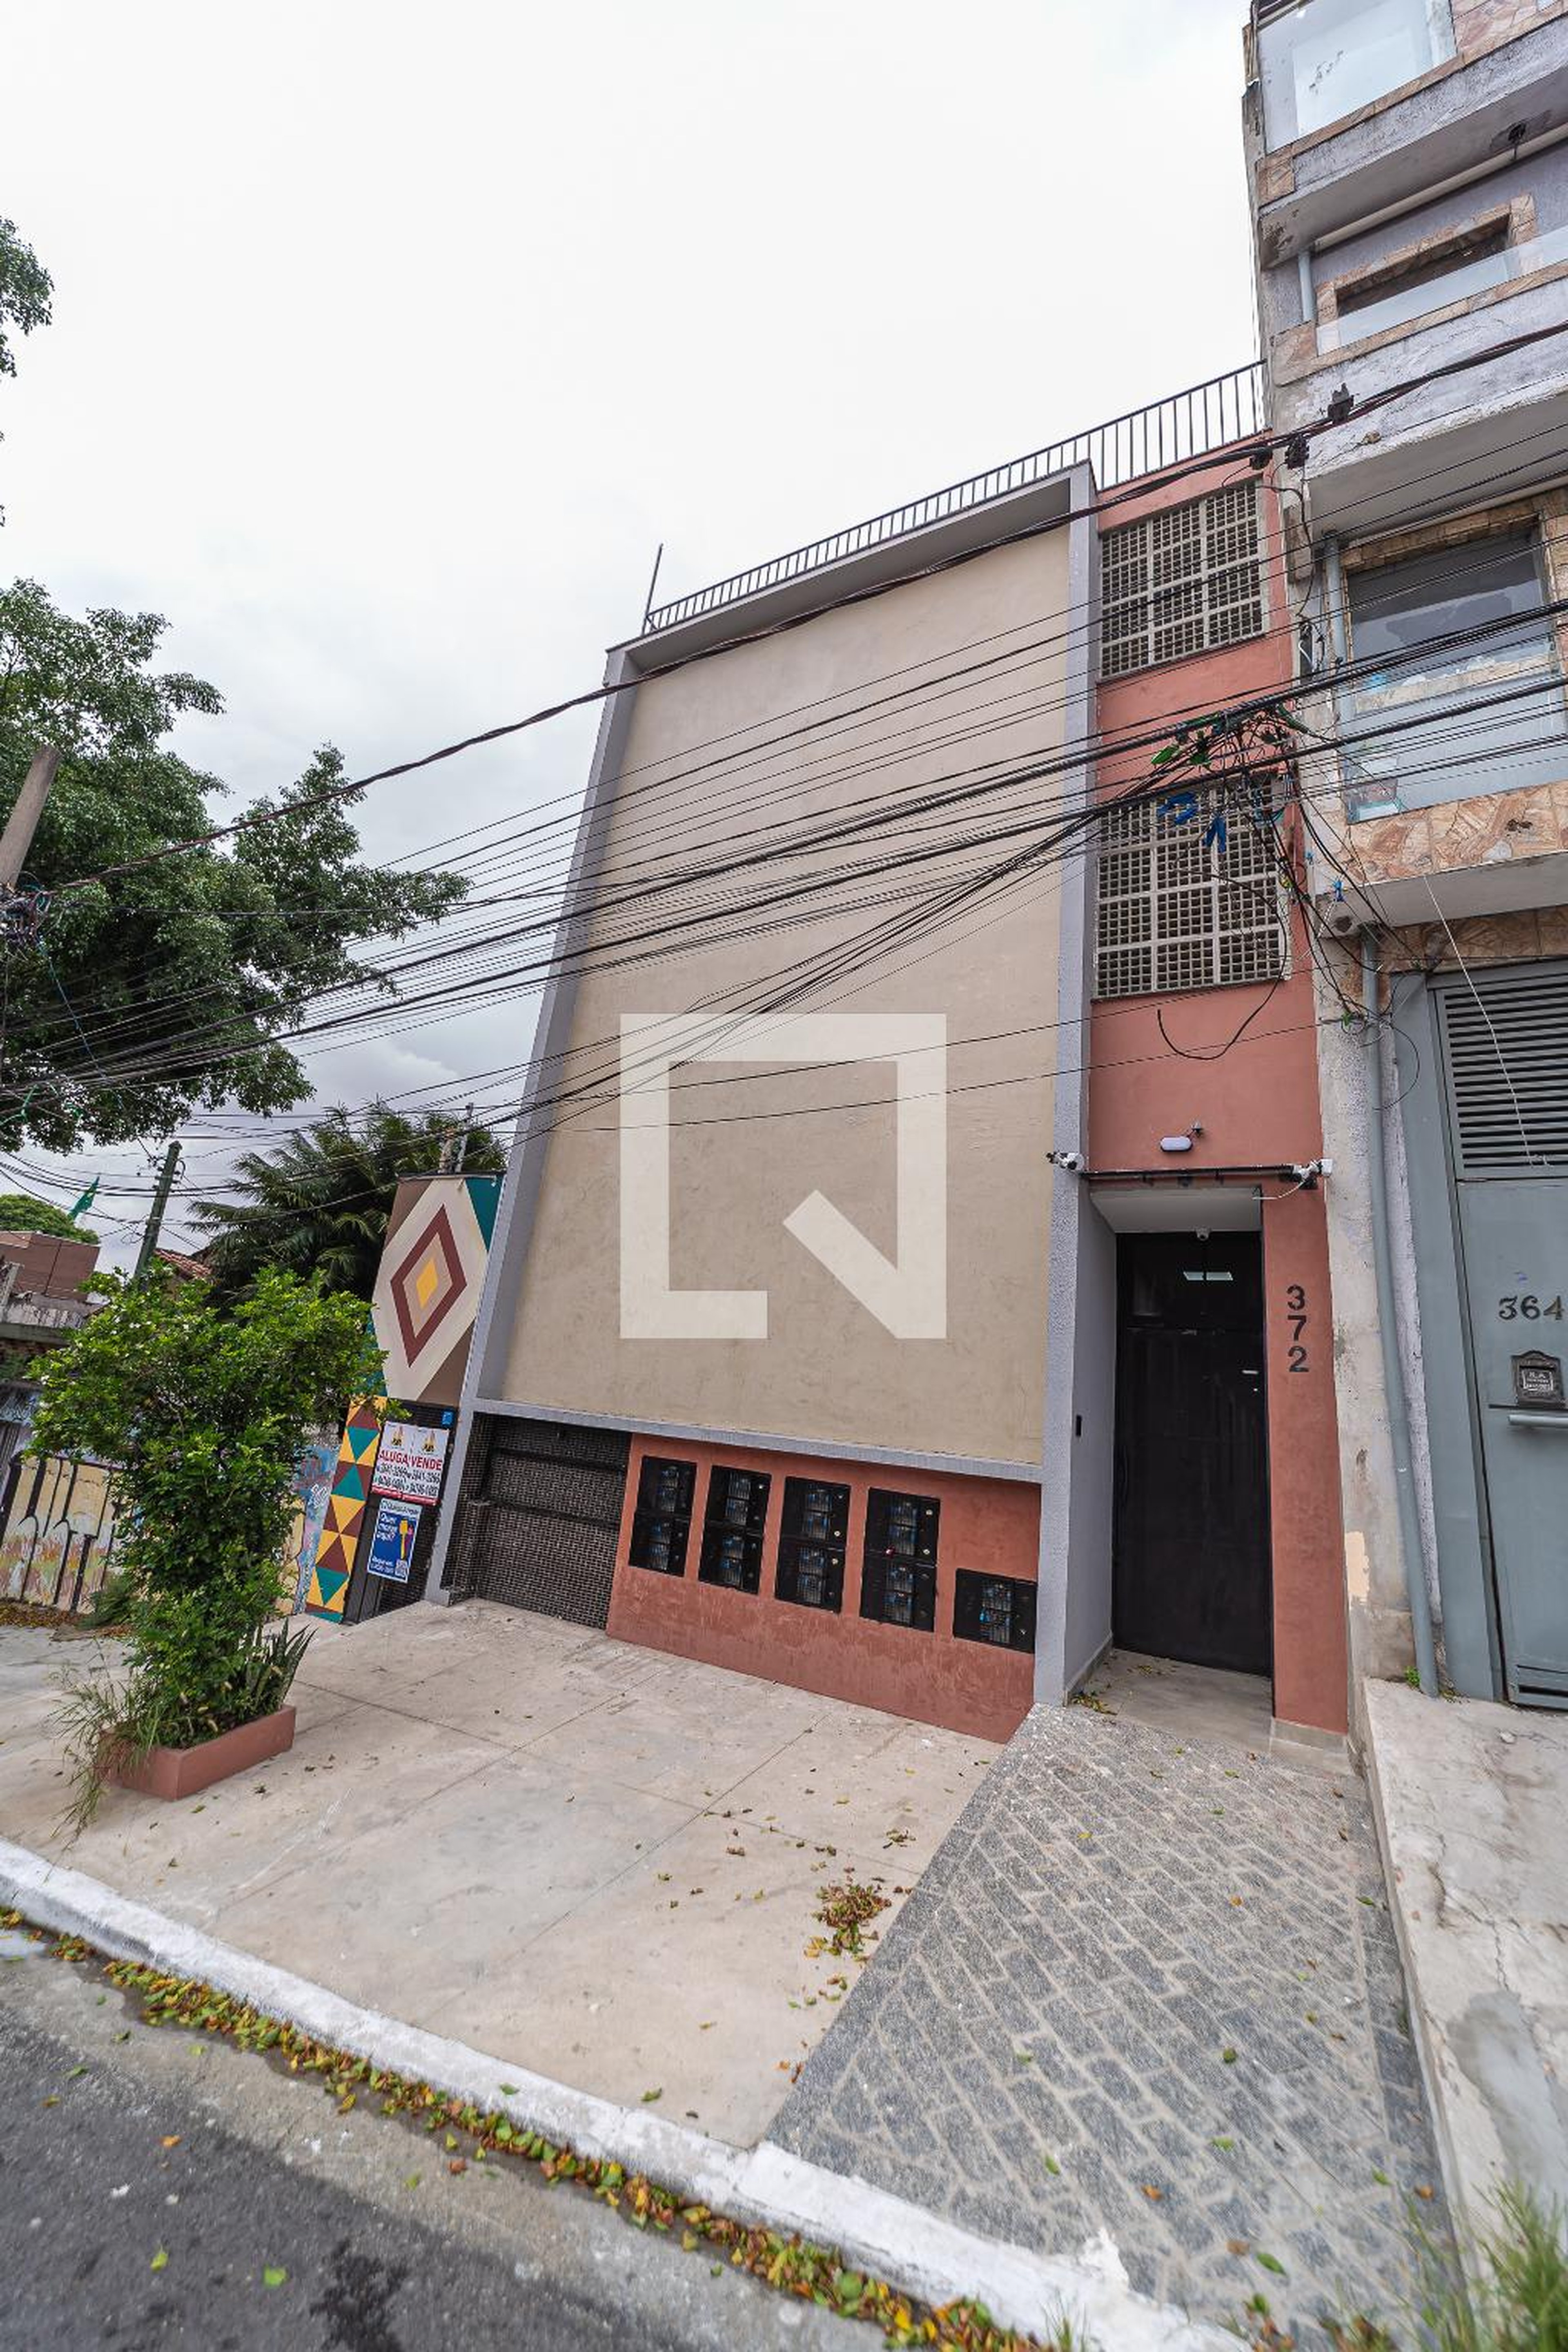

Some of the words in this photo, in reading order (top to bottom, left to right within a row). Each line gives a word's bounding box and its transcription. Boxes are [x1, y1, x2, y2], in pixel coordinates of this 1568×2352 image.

[1499, 1295, 1564, 1320] 364
[1287, 1285, 1309, 1372] 372
[379, 1450, 408, 1465] ALUGA
[410, 1456, 443, 1470] VENDE
